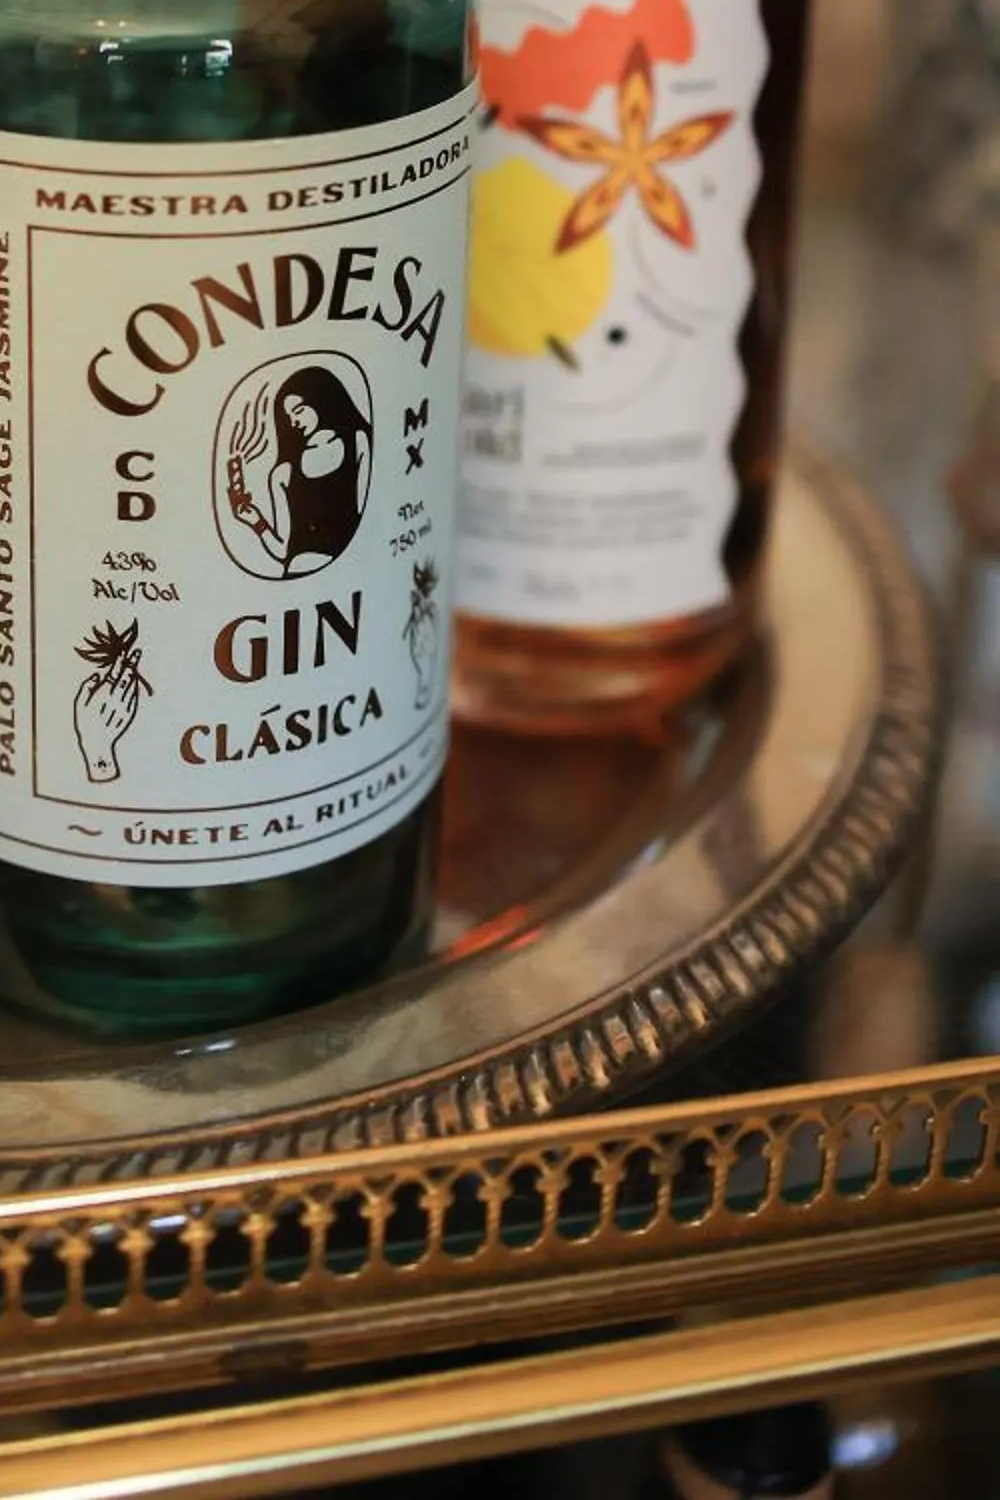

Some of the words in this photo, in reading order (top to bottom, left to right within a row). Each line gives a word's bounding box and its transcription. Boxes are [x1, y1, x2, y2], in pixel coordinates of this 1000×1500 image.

[35, 188, 249, 216] MAESTRA
[267, 135, 469, 212] DESTILADORA
[86, 247, 446, 417] CONDESA
[102, 550, 157, 572] 43%
[389, 529, 417, 558] 750
[212, 590, 362, 684] GIN
[180, 687, 384, 766] CLÁSICA
[123, 821, 250, 846] ÚNETE
[263, 812, 304, 838] AL
[316, 764, 407, 823] RITUAL
